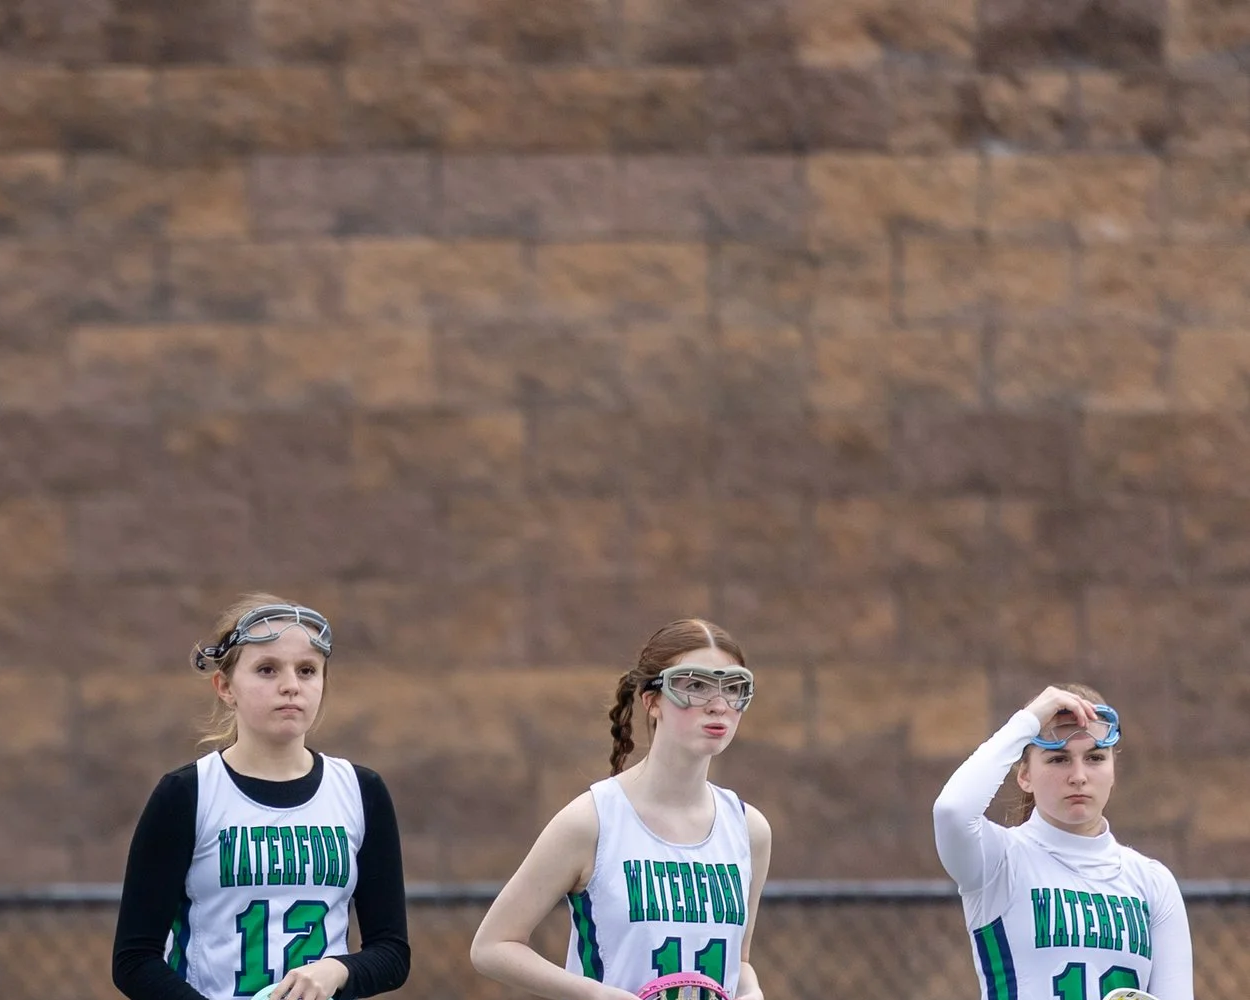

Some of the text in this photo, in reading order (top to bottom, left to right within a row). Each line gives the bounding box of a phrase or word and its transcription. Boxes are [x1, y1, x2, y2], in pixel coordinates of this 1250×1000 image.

[218, 825, 350, 888] WATERFORD
[623, 859, 745, 926] WATERFORD
[233, 900, 330, 997] 12
